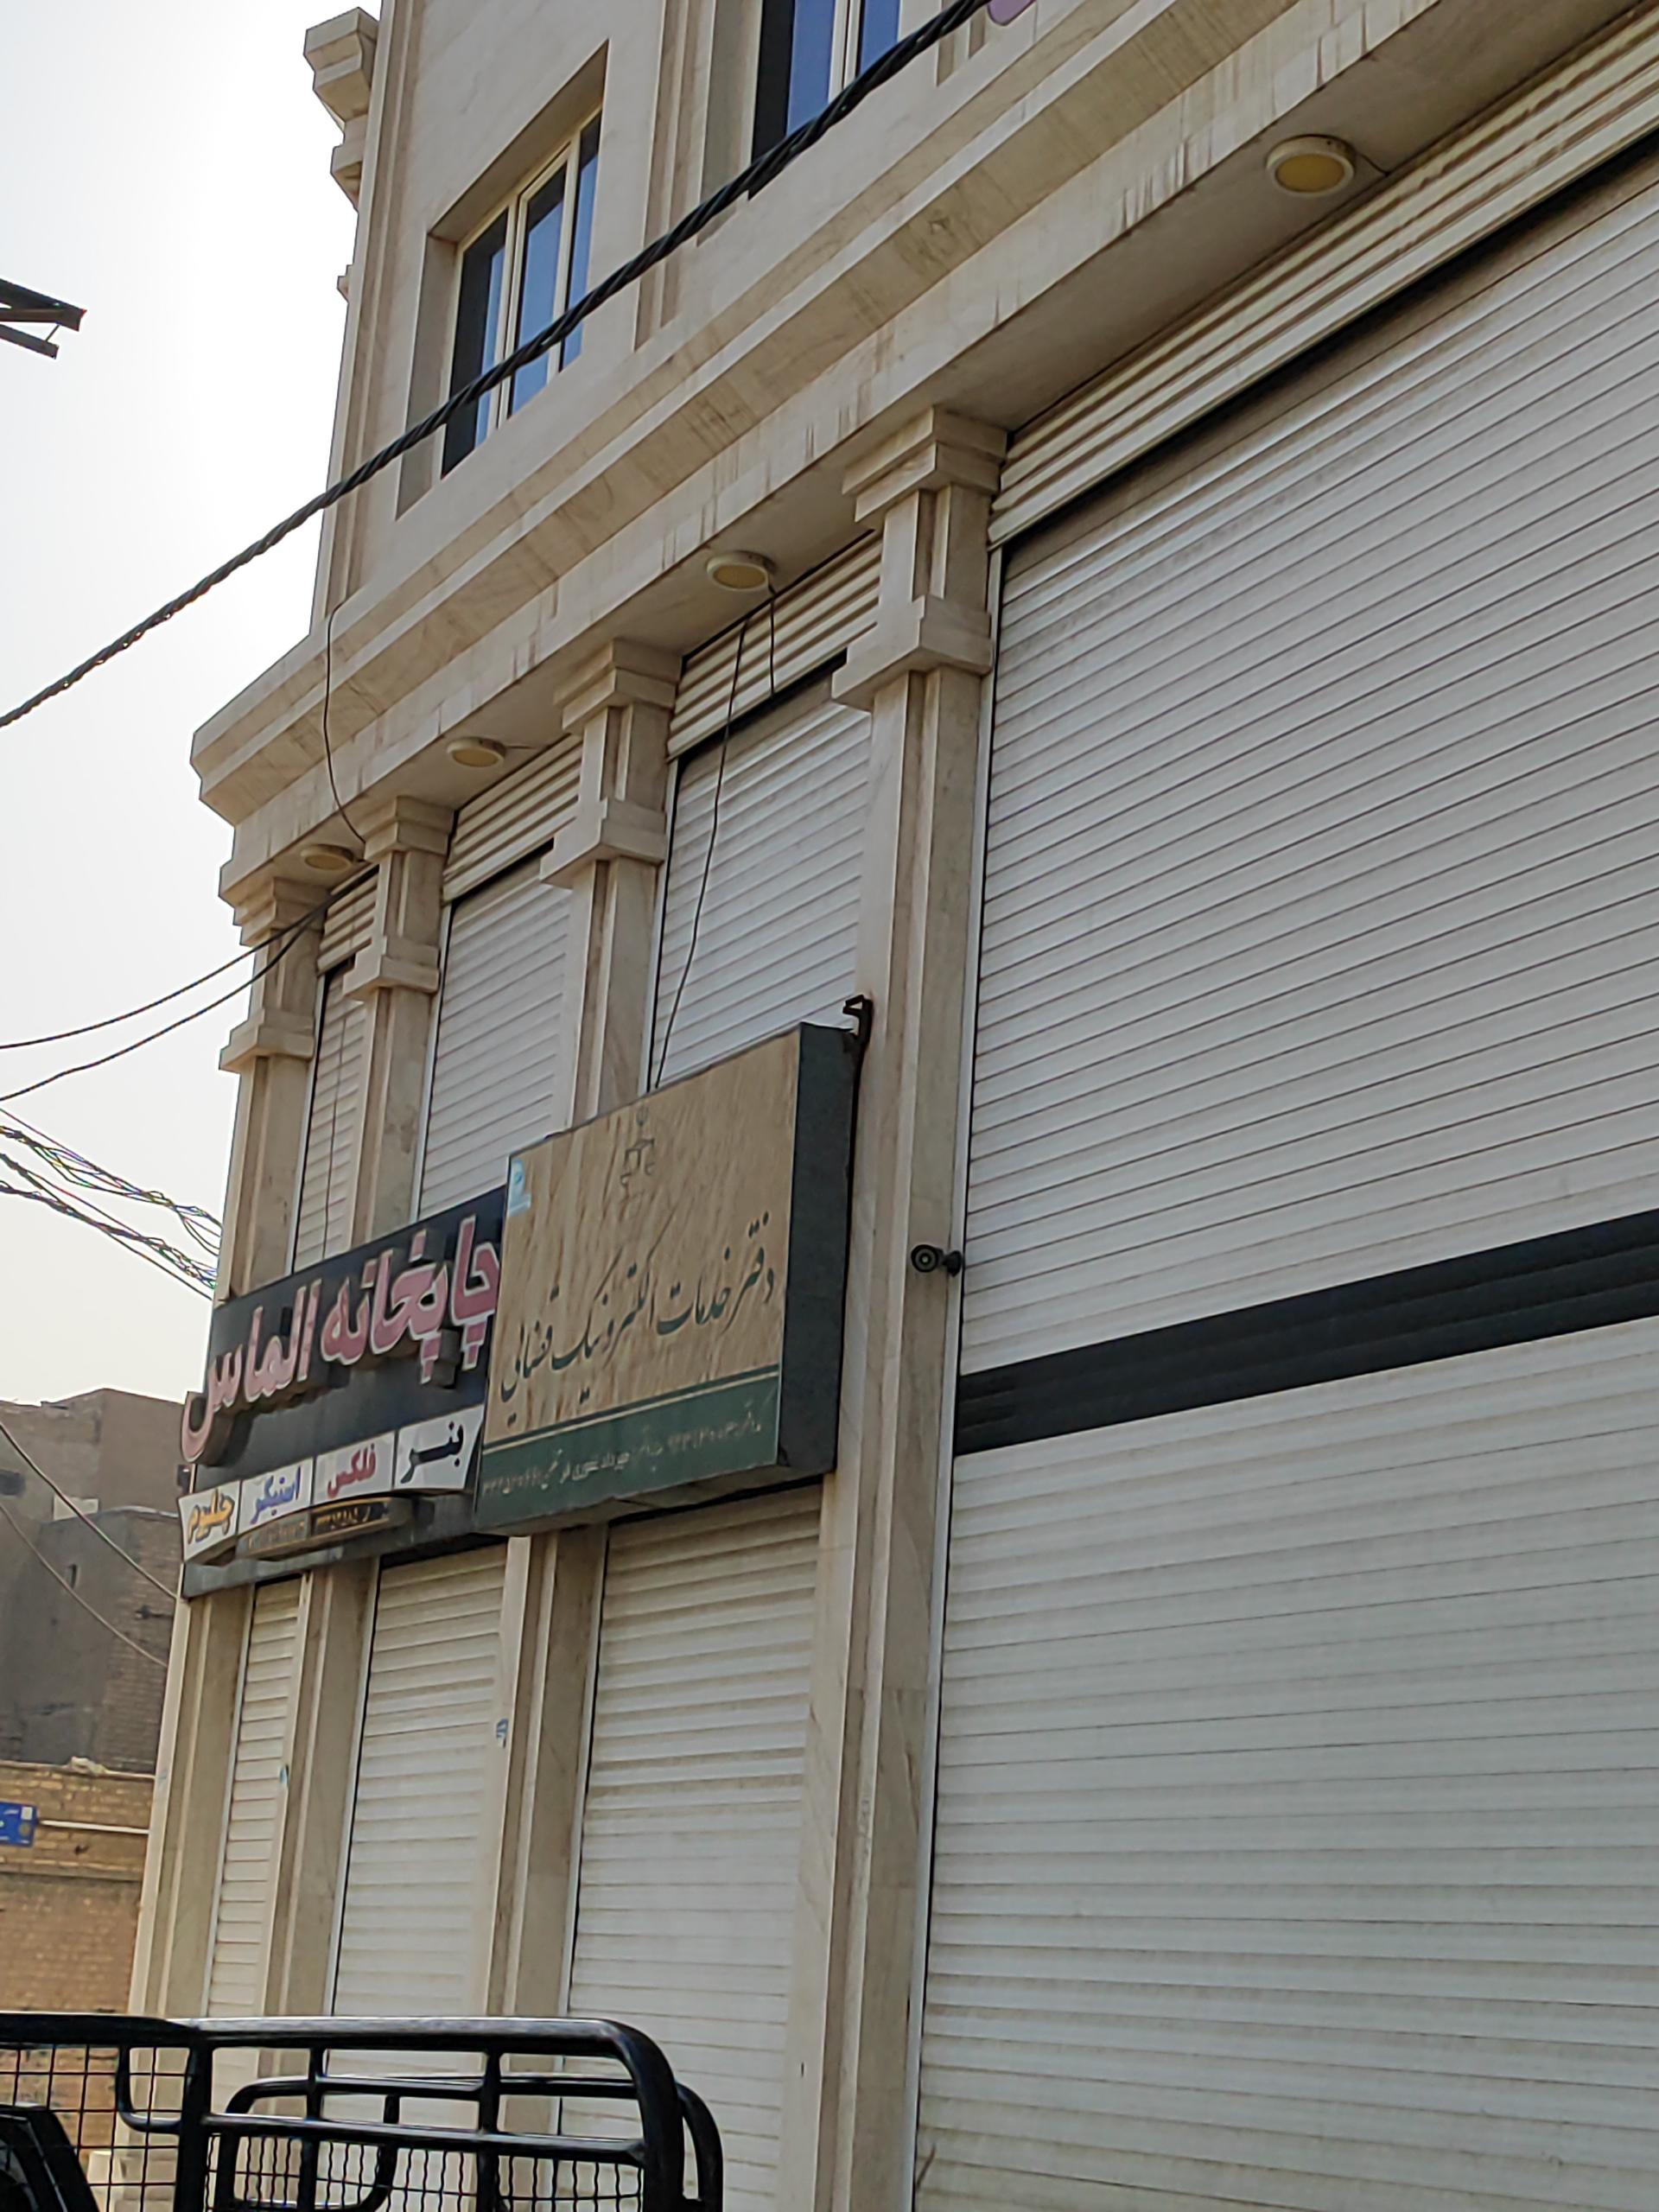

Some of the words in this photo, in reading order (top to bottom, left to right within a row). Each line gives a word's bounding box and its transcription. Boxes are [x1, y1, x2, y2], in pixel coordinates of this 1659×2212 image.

[321, 1214, 501, 1384] چاپخانه
[550, 1205, 677, 1405] الکترونیک
[656, 1246, 732, 1337] خدمات
[721, 1211, 776, 1336] دفتر
[181, 1278, 322, 1463] الماس
[327, 1442, 376, 1499] فلکس
[400, 1421, 464, 1484] بنر
